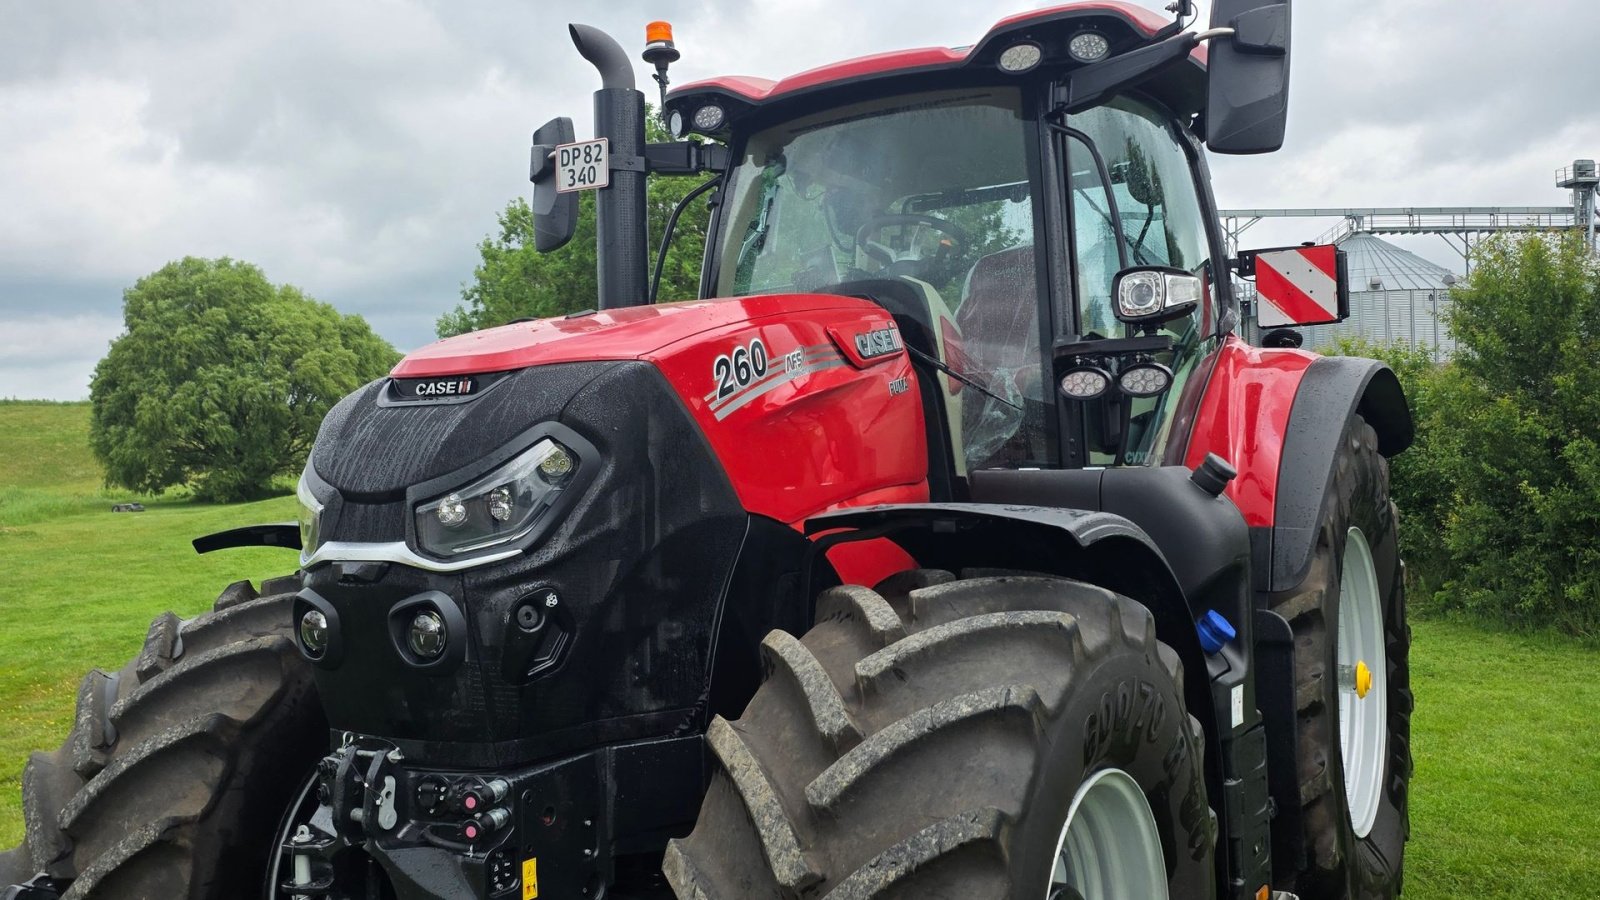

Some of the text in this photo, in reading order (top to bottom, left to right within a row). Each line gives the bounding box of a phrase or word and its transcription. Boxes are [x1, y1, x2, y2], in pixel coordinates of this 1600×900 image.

[561, 143, 602, 167] DP82
[567, 165, 596, 187] 340
[855, 330, 894, 357] CASE
[714, 337, 767, 401] 260
[785, 350, 803, 373] AFS
[415, 381, 456, 395] CASE
[888, 376, 909, 397] PUMA
